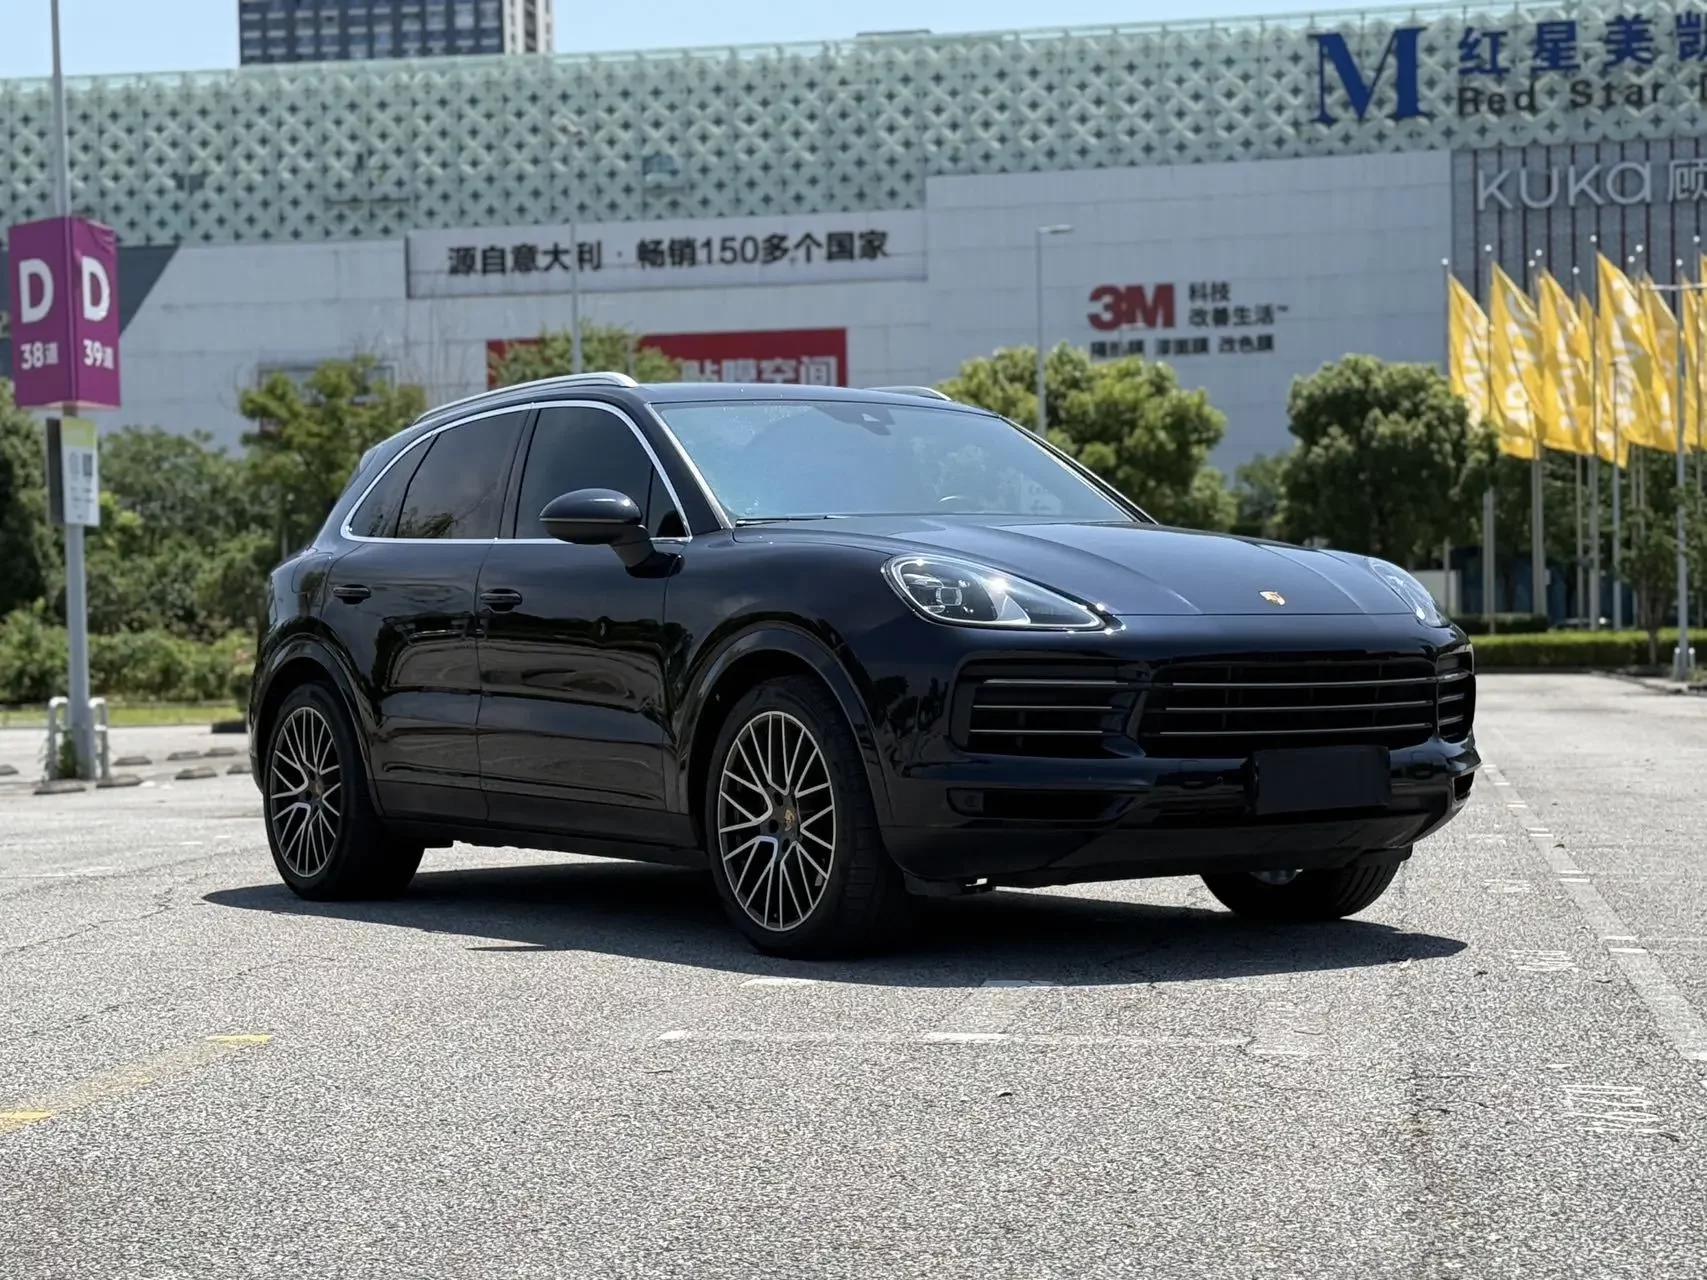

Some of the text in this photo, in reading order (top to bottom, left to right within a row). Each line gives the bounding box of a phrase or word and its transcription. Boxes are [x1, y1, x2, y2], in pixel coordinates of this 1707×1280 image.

[1307, 26, 1427, 124] M
[1458, 78, 1664, 116] Red Star
[19, 258, 54, 324] D
[81, 256, 110, 321] D
[1088, 283, 1175, 331] 3M
